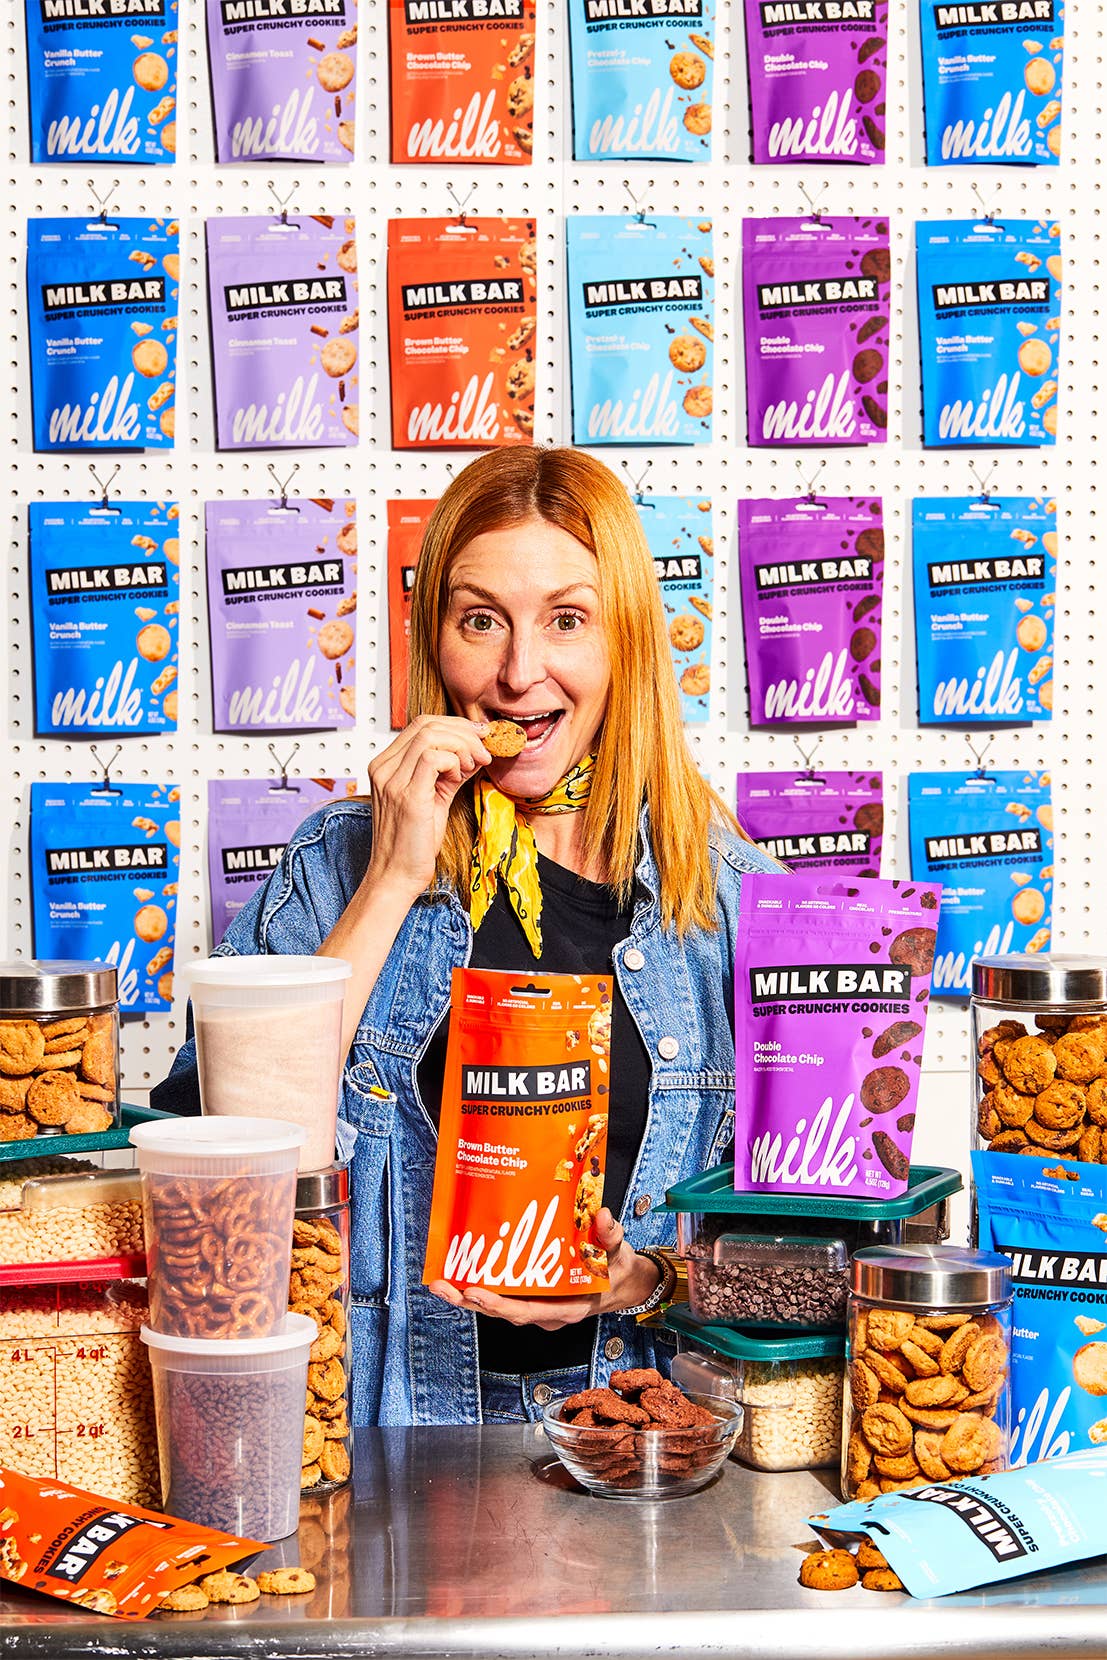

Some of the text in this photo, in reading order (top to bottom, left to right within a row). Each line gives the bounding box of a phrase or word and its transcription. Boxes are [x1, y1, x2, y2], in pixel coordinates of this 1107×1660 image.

[45, 0, 160, 17] MILK BAR
[225, 0, 341, 20] MILK BAR
[409, 0, 520, 20] MILK BAR
[587, 0, 699, 19] MILK BAR
[765, 1, 872, 23] MILK BAR
[938, 2, 1050, 26] MILK BAR
[224, 19, 346, 35] SUPER CRUNCHY COOKIES
[407, 22, 524, 35] SUPER CRUNCHY COOKIES
[587, 19, 702, 33] SUPER CRUNCHY COOKIES
[47, 86, 141, 155] milk
[231, 86, 319, 158] milk
[407, 89, 501, 158] milk
[589, 86, 681, 154] milk
[768, 88, 858, 157] milk
[941, 89, 1033, 159] milk
[47, 281, 161, 306] MILK BAR
[229, 281, 342, 307] MILK BAR
[406, 282, 520, 307] MILK BAR
[587, 280, 699, 303] MILK BAR
[762, 281, 874, 305] MILK BAR
[937, 282, 1047, 305] MILK BAR
[228, 304, 348, 322] SUPER CRUNCHY COOKIES
[404, 306, 525, 321] SUPER CRUNCHY COOKIES
[586, 304, 703, 319] SUPER CRUNCHY COOKIES
[49, 372, 141, 443] milk
[233, 373, 324, 444] milk
[408, 372, 500, 441] milk
[588, 371, 679, 439] milk
[763, 370, 856, 439] milk
[939, 371, 1025, 439] milk
[51, 566, 163, 592] MILK BAR
[226, 564, 340, 591] MILK BAR
[759, 560, 870, 587] MILK BAR
[931, 559, 1042, 584] MILK BAR
[225, 588, 344, 605] SUPER CRUNCHY COOKIES
[664, 582, 702, 592] COOKIES
[49, 622, 108, 631] Vanilla Butter
[50, 631, 81, 640] Crunch
[52, 657, 143, 726] milk
[229, 656, 321, 725] milk
[765, 649, 854, 718] milk
[934, 648, 1023, 715] milk
[818, 834, 866, 853] BAR
[928, 832, 1038, 858] MILK BAR
[51, 849, 163, 870] MILK BAR
[226, 848, 284, 869] MILK
[225, 874, 255, 884] SUPER
[755, 970, 904, 997] MILK BAR
[753, 1002, 910, 1017] SUPER CRUNCHY COOKIES
[754, 1041, 781, 1051] Double
[754, 1052, 824, 1066] Chocolate Chip
[467, 1067, 586, 1095] MILK BAR
[461, 1100, 592, 1116] SUPER CRUNCHY COOKIES
[458, 1138, 520, 1155] Brown Butter
[751, 1093, 857, 1186] milk
[457, 1151, 528, 1169] Chocolate Chip
[444, 1195, 564, 1287] milk
[1004, 1252, 1059, 1280] ILK
[1017, 1287, 1069, 1301] CRUNCHY
[1009, 1386, 1071, 1468] ilk
[948, 1496, 1019, 1556] MILK
[1007, 1513, 1039, 1553] SUPER
[33, 1528, 75, 1574] COOKIES
[55, 1524, 117, 1575] BAR
